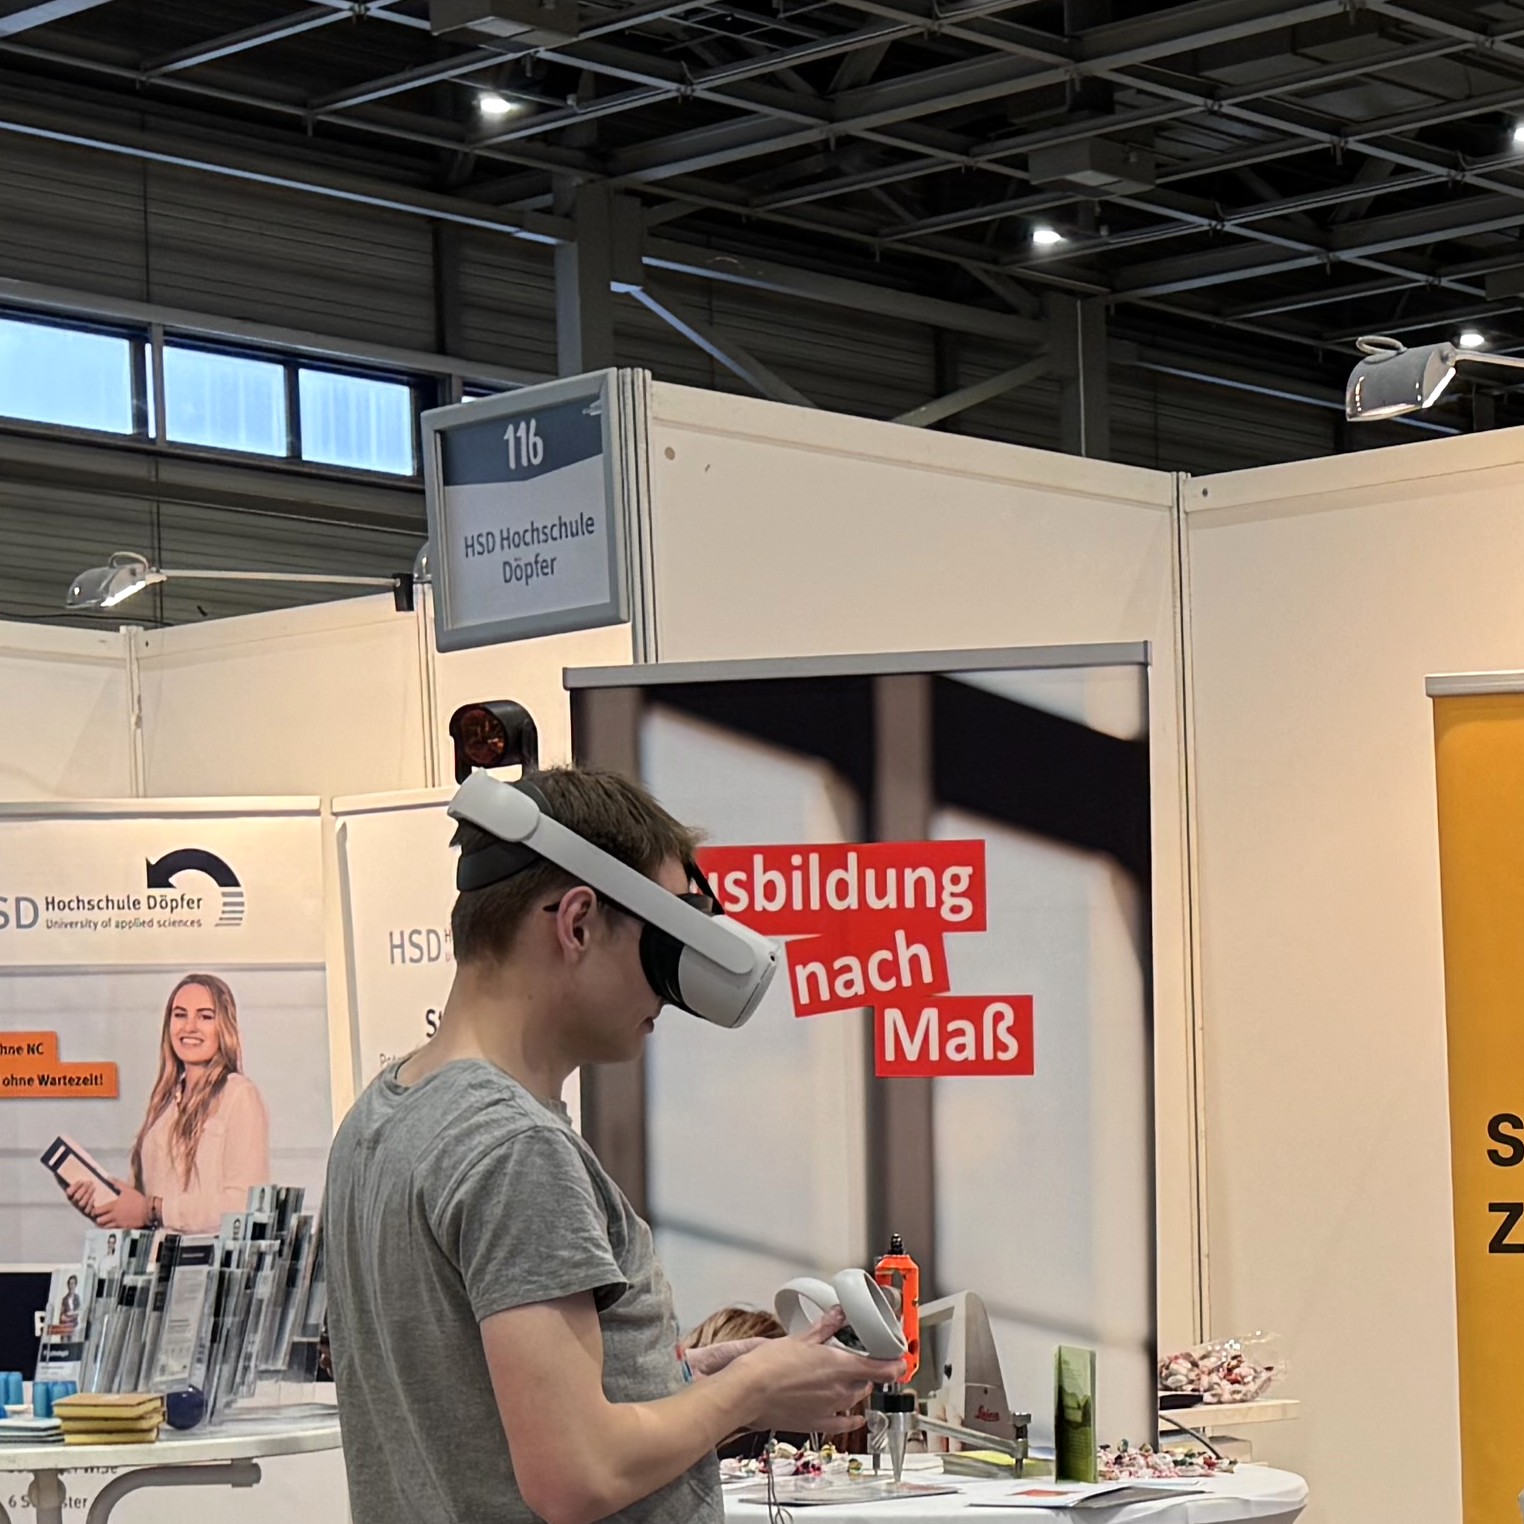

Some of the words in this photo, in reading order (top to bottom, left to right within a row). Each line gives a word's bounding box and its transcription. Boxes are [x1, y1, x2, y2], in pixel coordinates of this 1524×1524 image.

[503, 417, 545, 470] 116
[464, 533, 497, 559] HSD
[500, 511, 596, 552] Hochschule
[502, 555, 558, 587] Döpfer
[45, 895, 142, 913] Hochschule
[146, 893, 203, 914] Döpfer
[45, 917, 99, 932] University
[101, 917, 113, 929] of
[156, 918, 203, 930] sciences
[388, 928, 442, 965] HSD
[794, 929, 934, 1006] nach
[883, 1001, 1020, 1063] Maß
[26, 1042, 45, 1056] NC
[2, 1076, 34, 1087] ohne
[37, 1073, 104, 1087] Wartezeit!
[8, 1496, 17, 1509] 6
